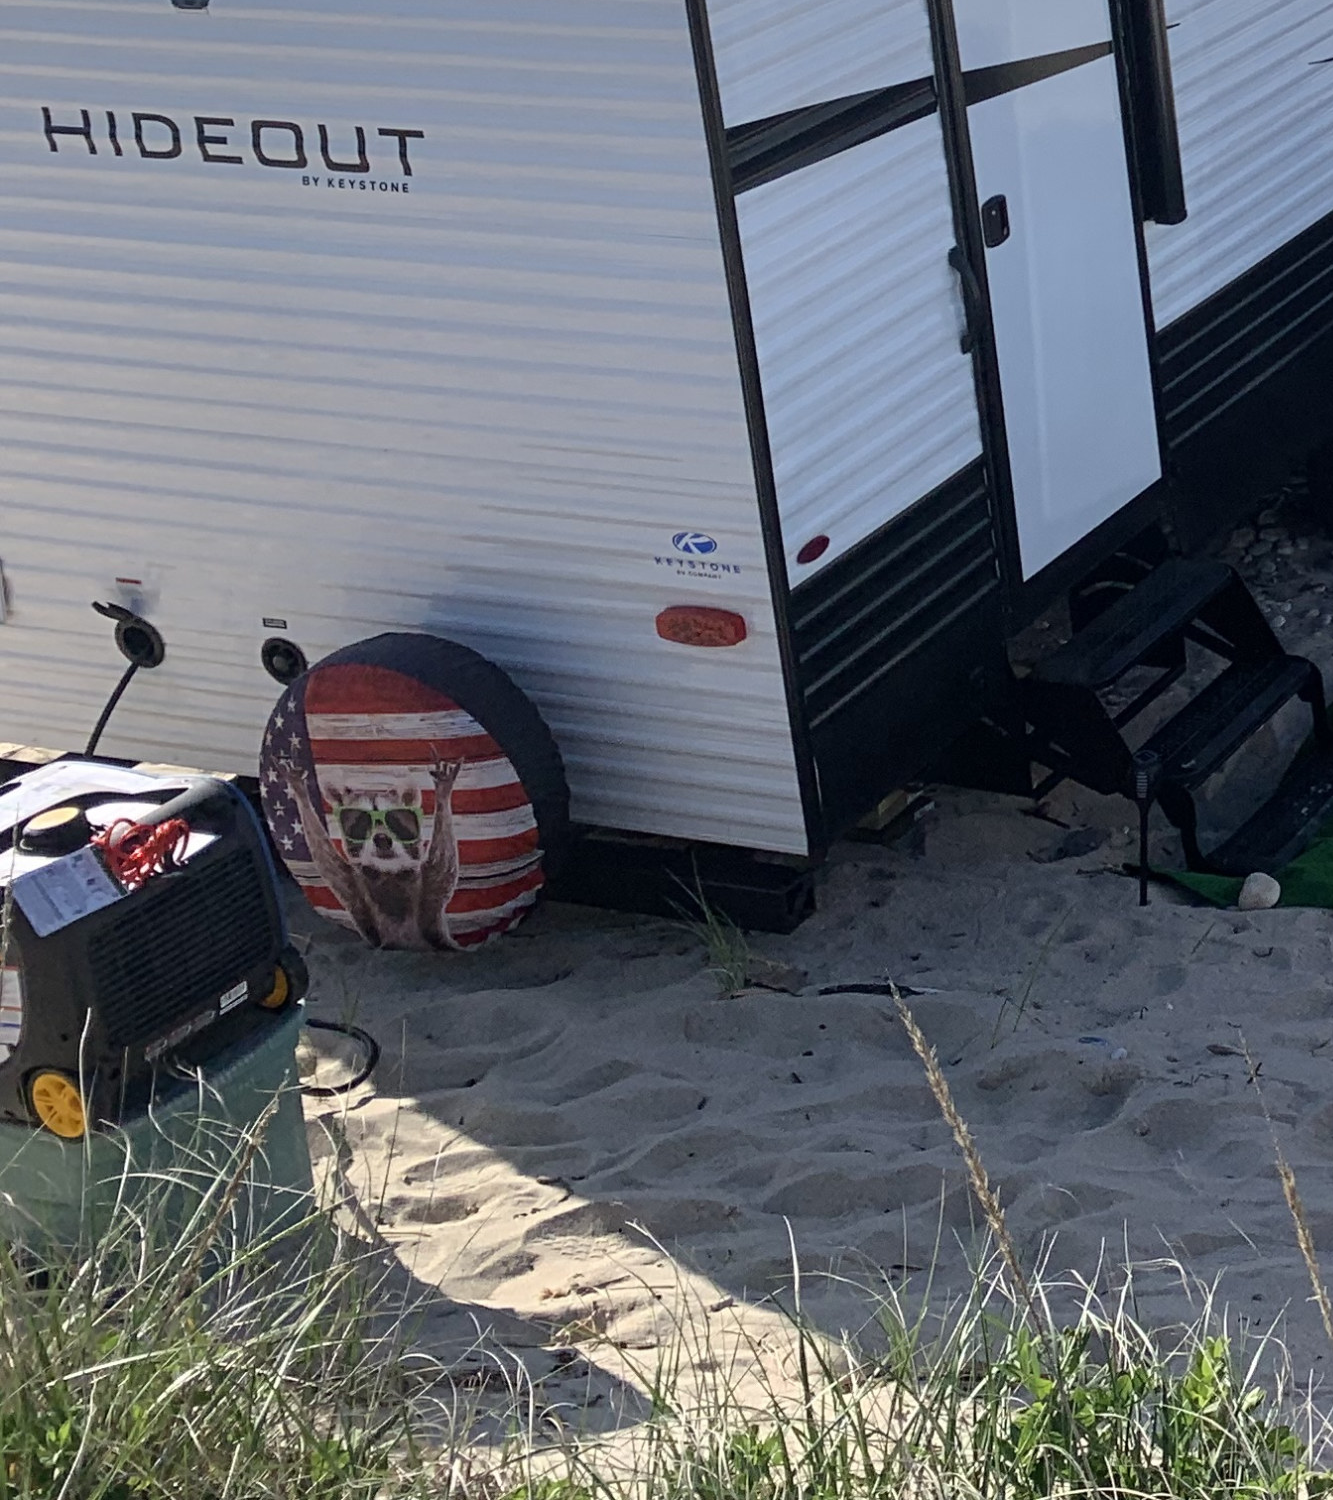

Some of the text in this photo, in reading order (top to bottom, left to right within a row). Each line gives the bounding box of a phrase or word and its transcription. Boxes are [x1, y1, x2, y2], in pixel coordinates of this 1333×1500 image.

[41, 106, 425, 176] HIDEOUT
[302, 175, 410, 194] BY KEYSTONE
[654, 556, 741, 574] KEYSTONE
